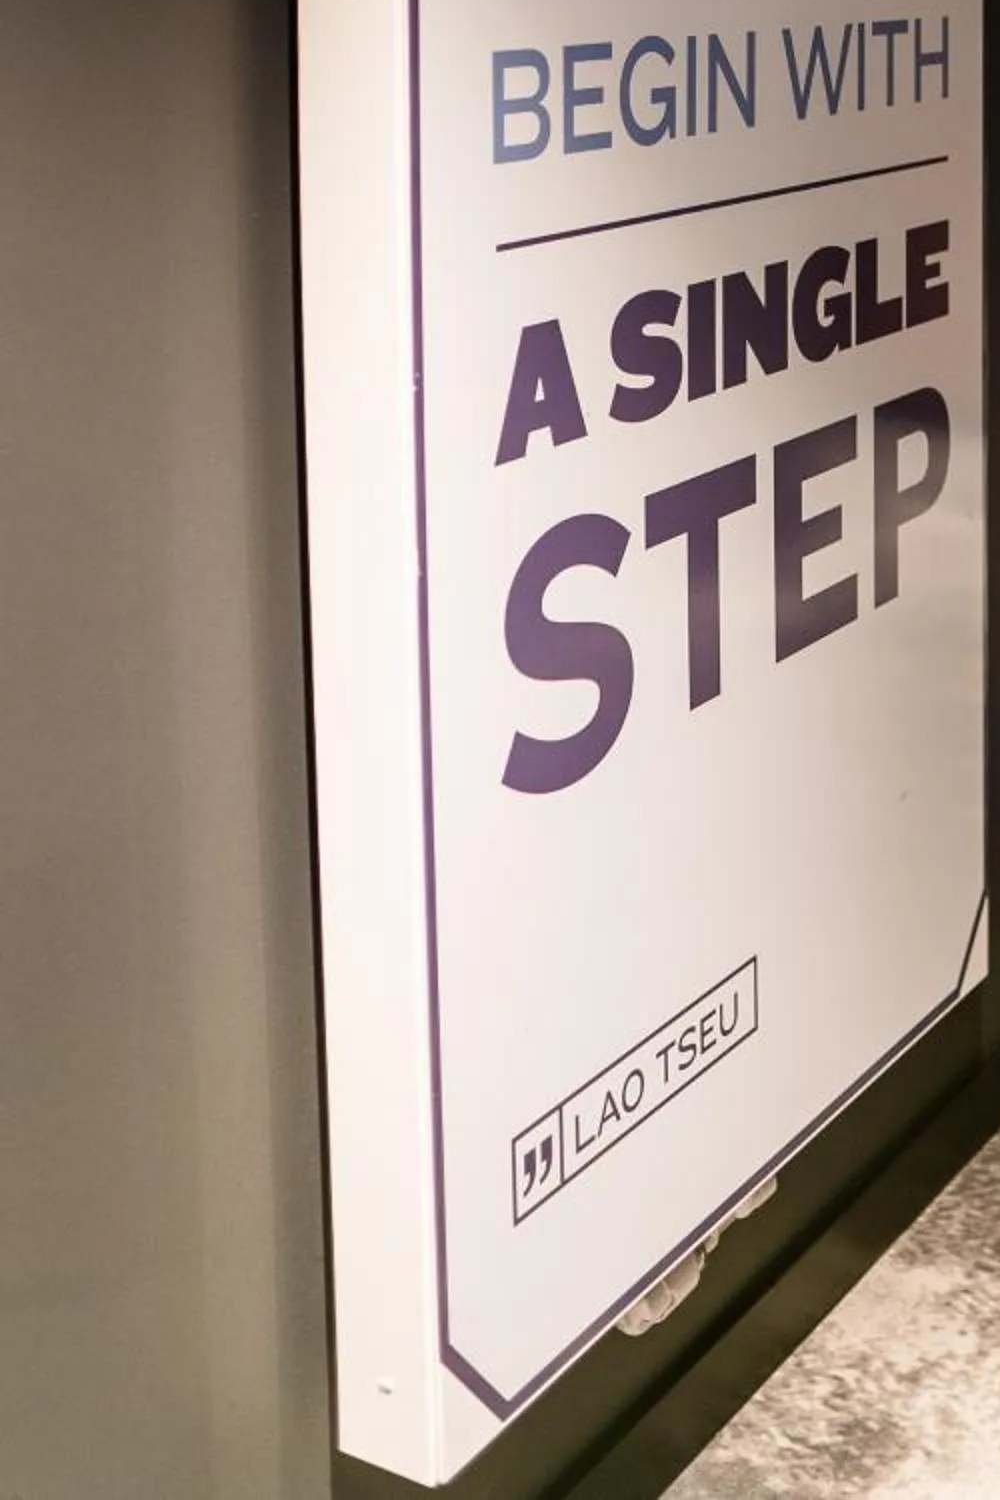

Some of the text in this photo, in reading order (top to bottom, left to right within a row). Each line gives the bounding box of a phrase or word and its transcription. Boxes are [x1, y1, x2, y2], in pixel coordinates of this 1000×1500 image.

[493, 16, 949, 164] BEGIN WITH
[496, 219, 949, 466] A SINGLE
[502, 387, 950, 794] STEP
[575, 992, 739, 1154] LAO TSEU
